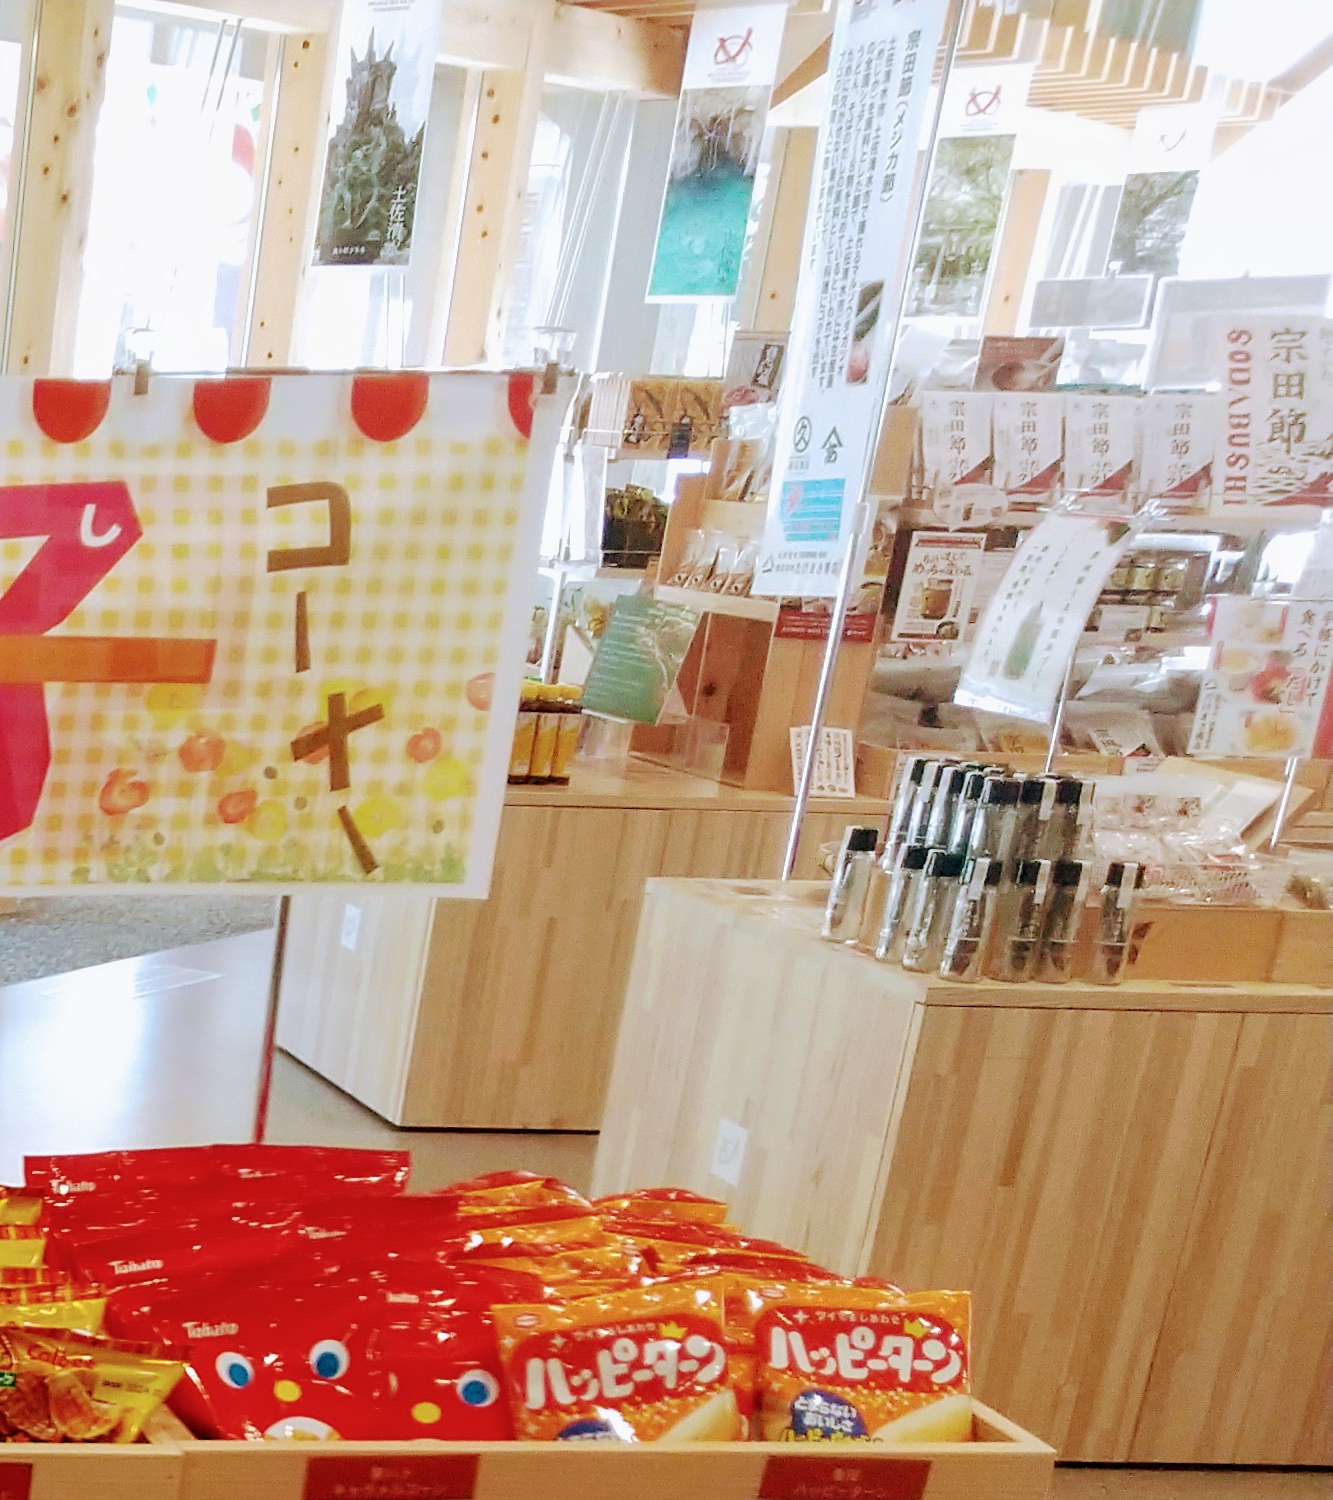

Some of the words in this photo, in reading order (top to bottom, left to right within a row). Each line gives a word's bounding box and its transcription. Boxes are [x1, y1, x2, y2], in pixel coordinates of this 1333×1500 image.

[1263, 326, 1311, 456] 宗田節
[80, 502, 123, 549] し
[266, 480, 385, 874] コーナー
[526, 1334, 724, 1409] ハッピーターン
[769, 1325, 962, 1384] ハッピーターン
